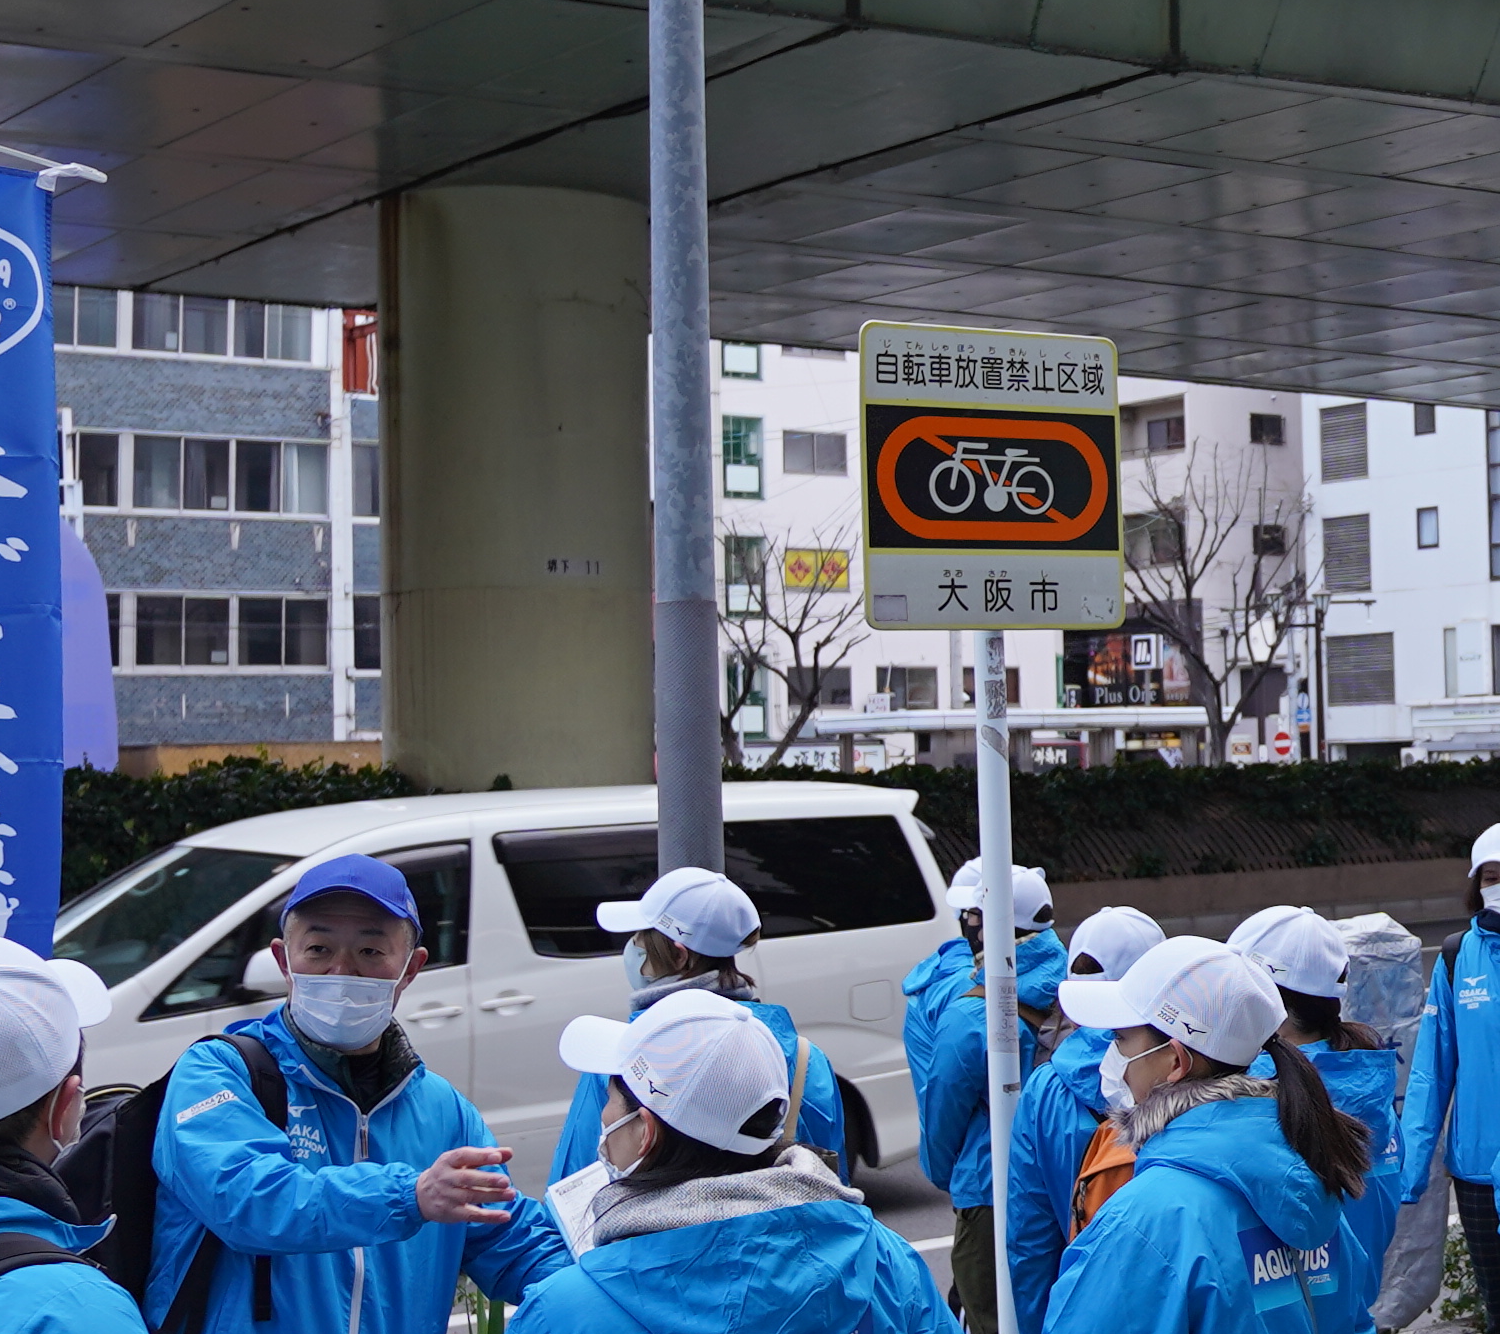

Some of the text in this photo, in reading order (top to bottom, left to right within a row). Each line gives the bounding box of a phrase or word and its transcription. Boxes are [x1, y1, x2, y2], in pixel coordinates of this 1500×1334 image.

[876, 350, 1105, 395] 自転車放置禁止区域
[937, 577, 1060, 613] 大阪市
[1094, 686, 1124, 705] Plus
